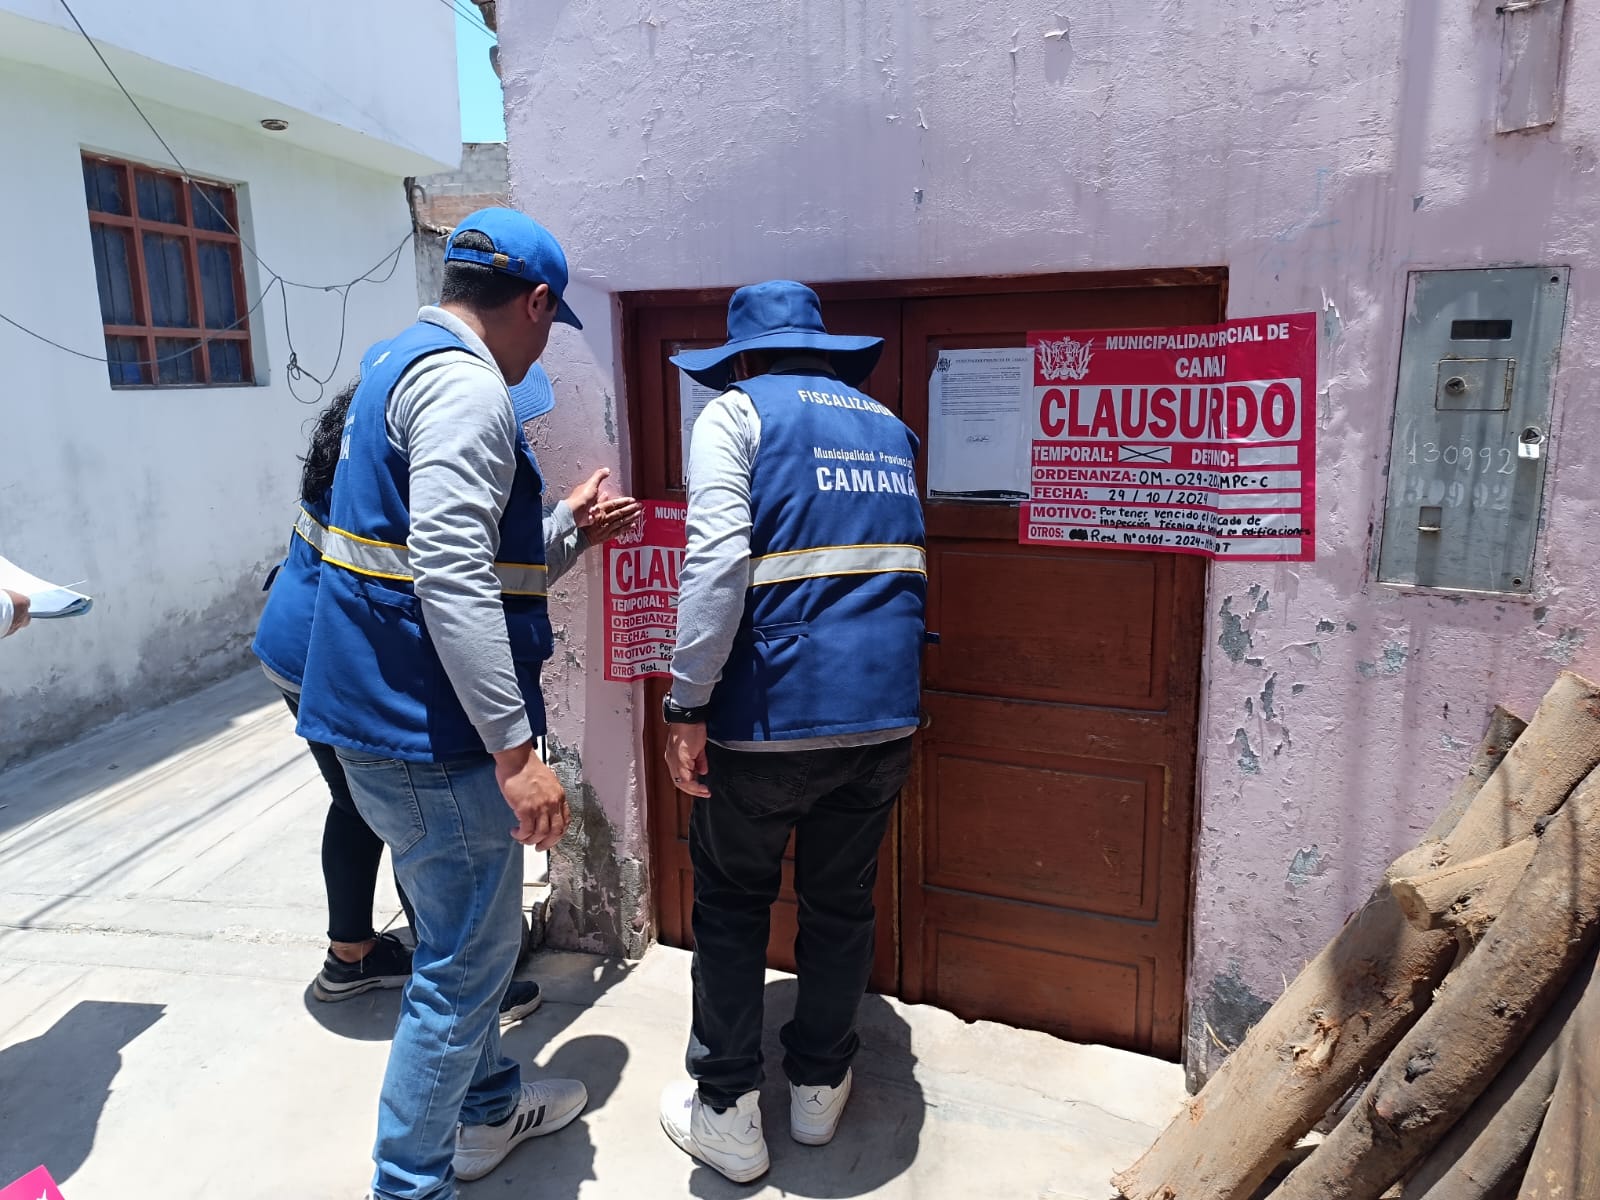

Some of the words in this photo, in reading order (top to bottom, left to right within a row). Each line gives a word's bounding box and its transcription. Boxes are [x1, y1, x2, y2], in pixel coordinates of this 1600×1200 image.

[1266, 323, 1290, 340] DE
[1040, 382, 1296, 439] CLAUSURDO
[813, 447, 876, 462] Municipalidad
[1033, 446, 1113, 462] TEMPORAL:
[1408, 430, 1515, 475] 130992
[816, 466, 918, 498] CAMANÁ
[1034, 469, 1136, 482] ORDENANZA:
[1034, 487, 1088, 499] FECHA:
[655, 506, 687, 521] MUNIC
[1033, 507, 1096, 519] MOTIVO:
[1099, 507, 1117, 517] Por
[1119, 508, 1148, 518] tener
[1247, 515, 1262, 526] de
[1030, 527, 1064, 538] OTROS:
[616, 549, 684, 592] CLAU
[611, 595, 665, 612] TEMPORAL:
[613, 630, 649, 642] FECHA:
[613, 645, 656, 659] MOTIVO:
